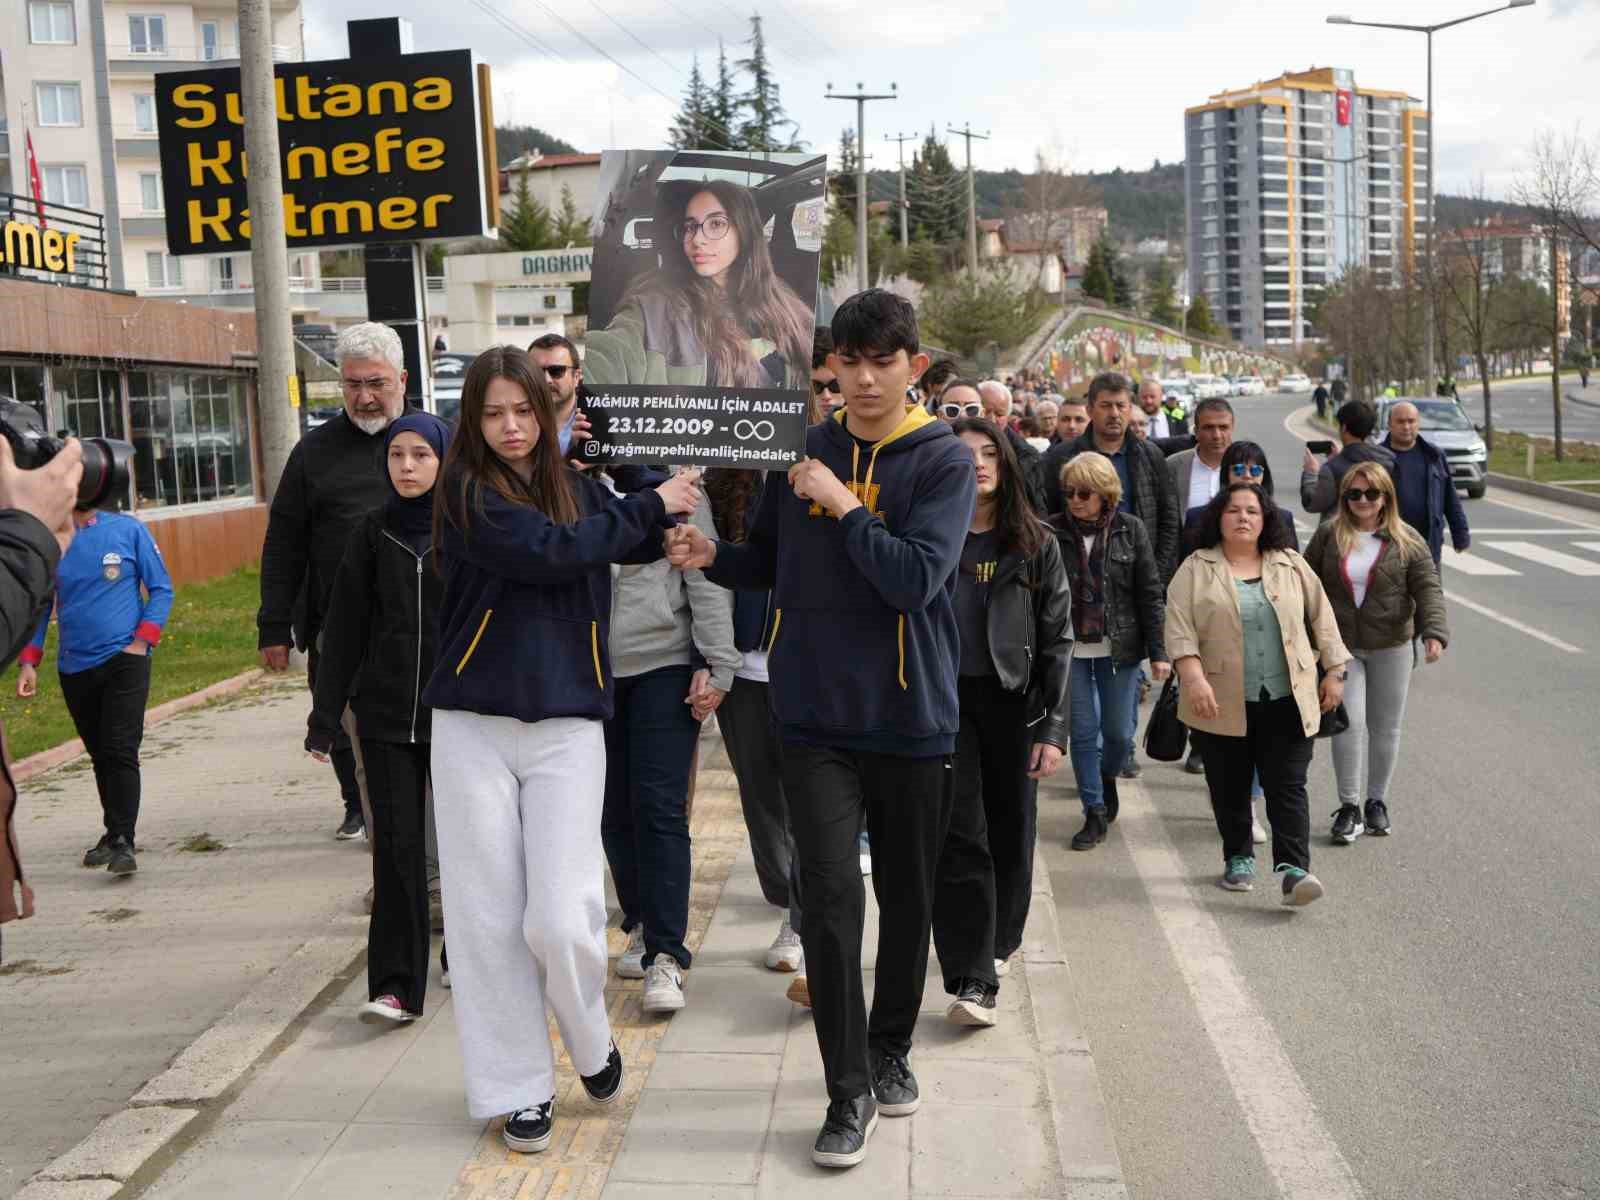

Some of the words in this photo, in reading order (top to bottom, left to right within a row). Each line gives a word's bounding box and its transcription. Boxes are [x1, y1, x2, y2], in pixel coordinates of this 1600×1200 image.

[187, 128, 446, 187] Knefe
[0, 220, 80, 273] mer
[585, 393, 640, 408] YAĞMUR
[643, 394, 718, 410] PEHLİVANLI
[722, 396, 749, 414] İÇİN
[752, 400, 805, 414] ADALET
[608, 416, 714, 435] 23.12.2009
